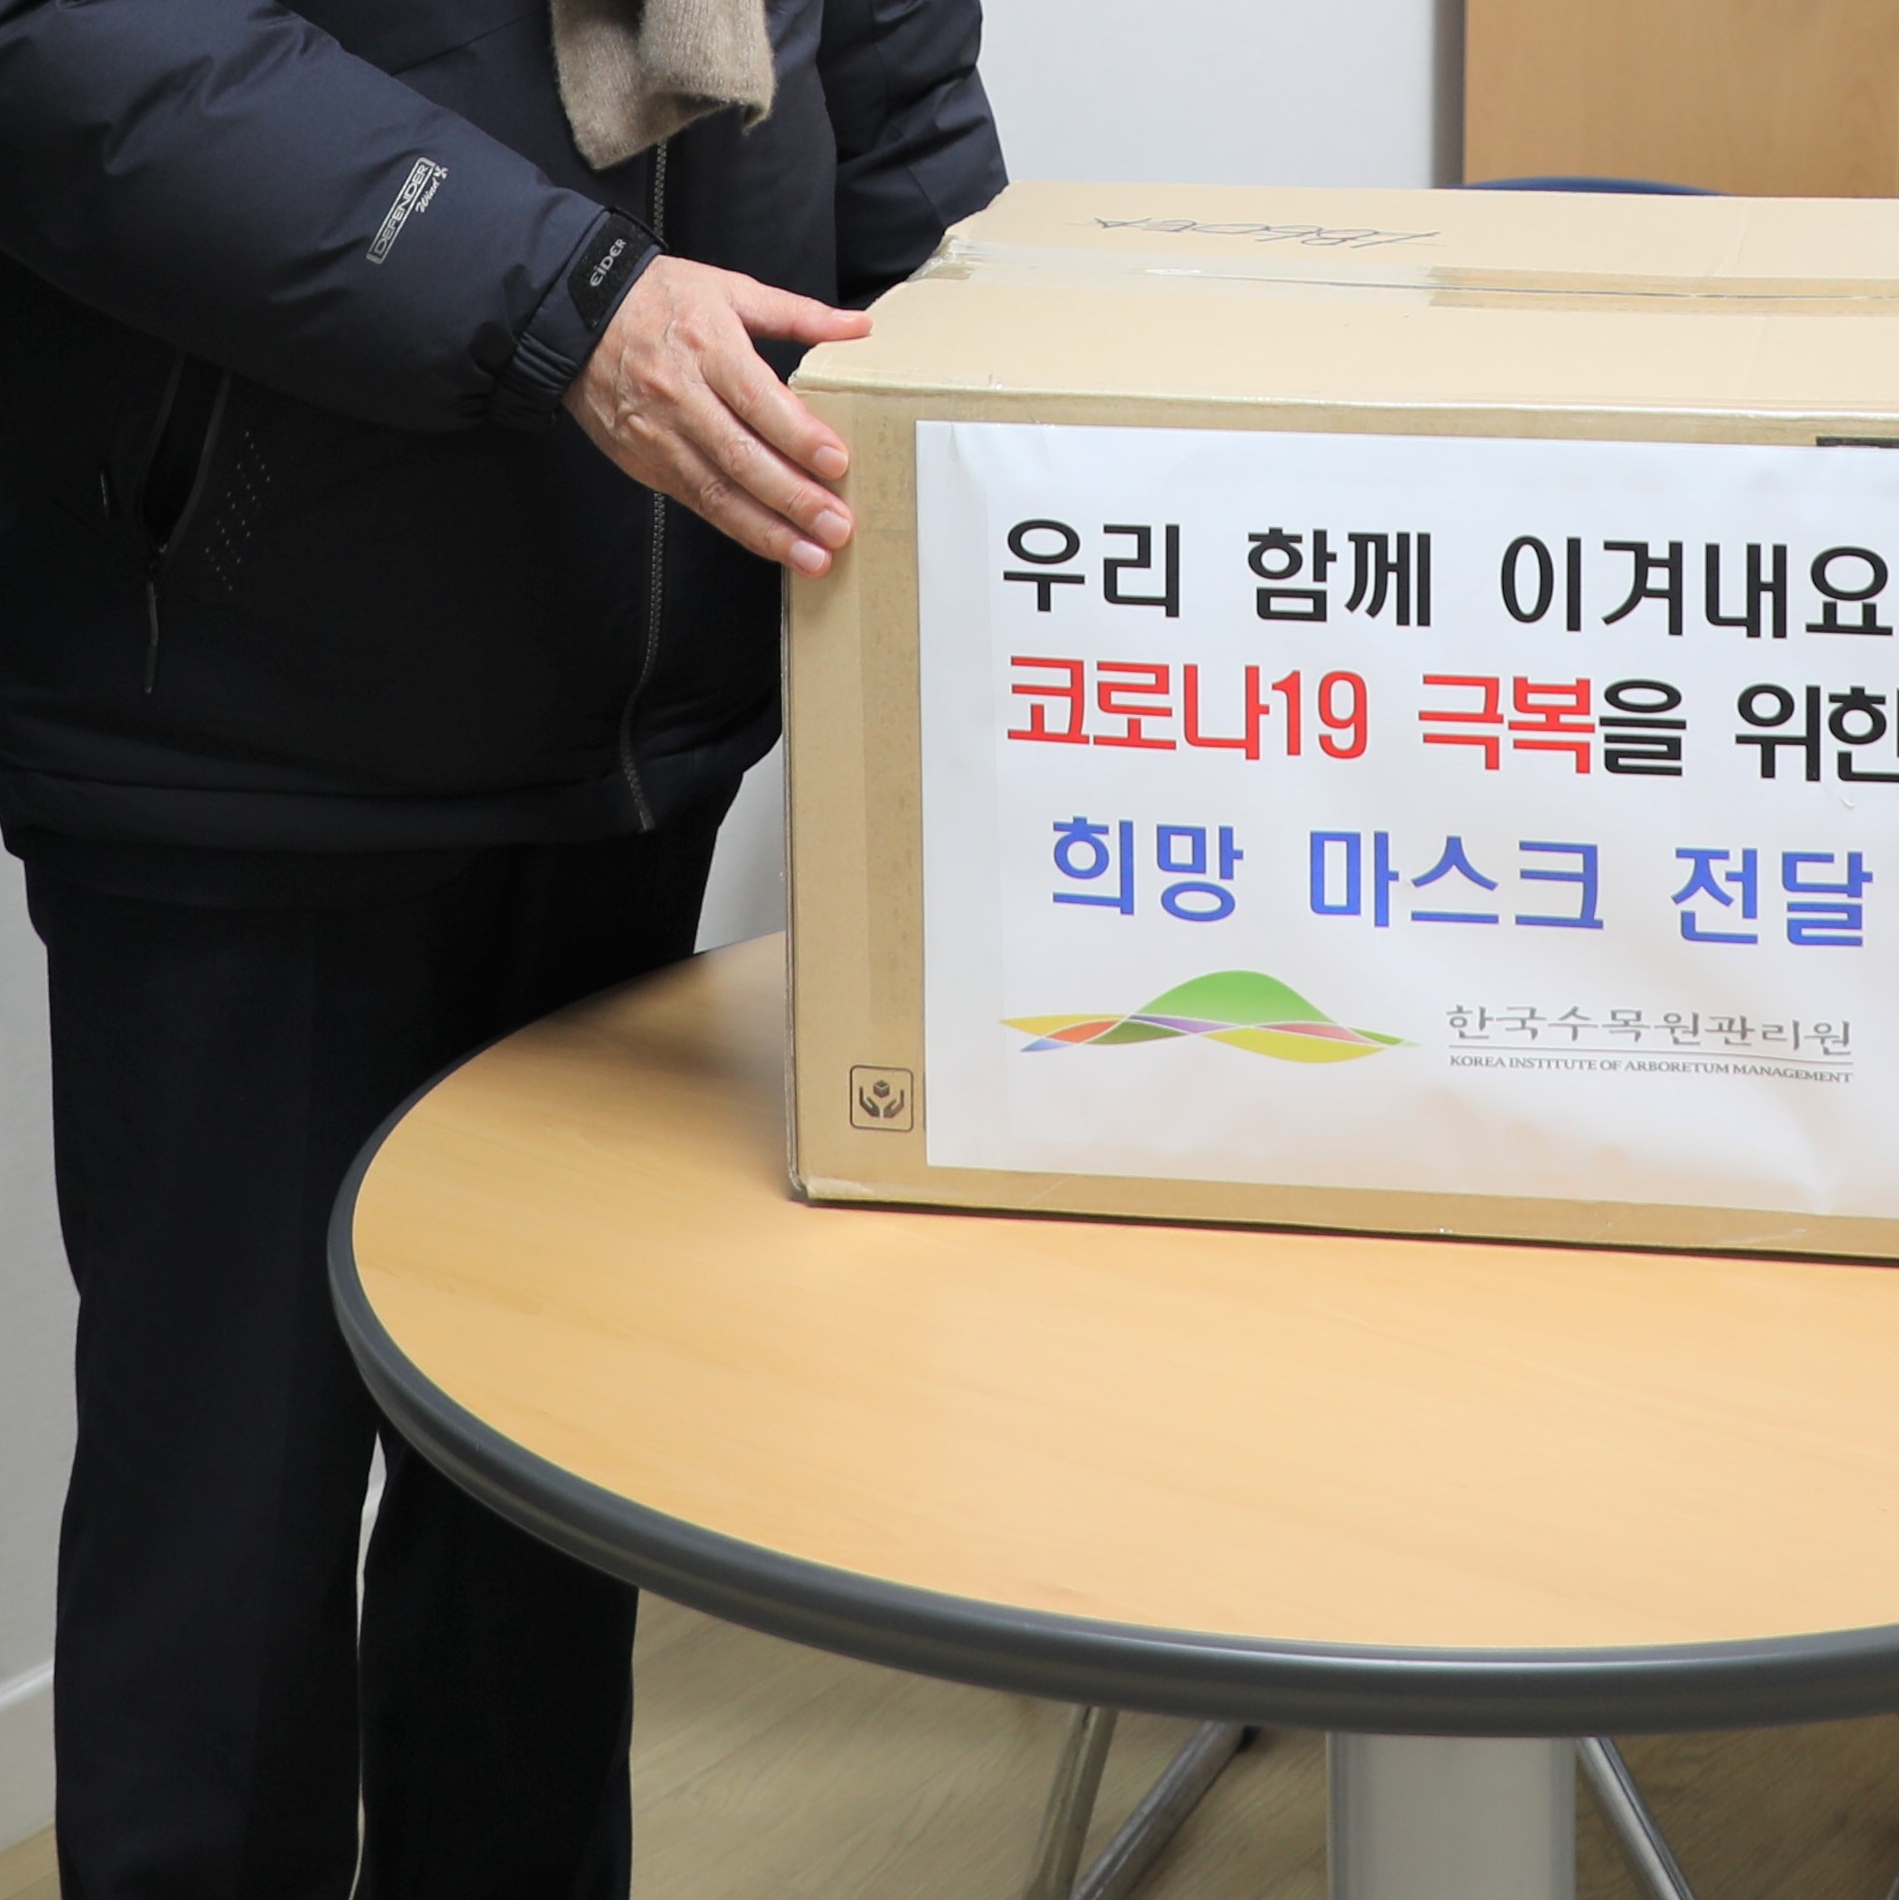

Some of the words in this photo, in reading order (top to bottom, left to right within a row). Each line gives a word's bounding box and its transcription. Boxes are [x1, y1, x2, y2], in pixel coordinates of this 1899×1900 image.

[373, 164, 430, 255] DEFENDER
[1002, 518, 1181, 619] 우리
[1246, 526, 1432, 628] 함께
[1006, 655, 1369, 762] 코로나19
[1417, 674, 1688, 778] 극복을
[1052, 816, 1245, 923] 희망
[1309, 830, 1605, 932] 마스크
[1671, 846, 1874, 948] 전달
[1445, 1003, 1853, 1056] 한국수목원관리원
[1450, 1054, 1507, 1068] KOREA
[1508, 1056, 1597, 1070] INSTITUTE
[1599, 1058, 1622, 1071] OF
[1623, 1060, 1730, 1075] ARBORETUM
[1732, 1063, 1852, 1084] MANAGEMENT
